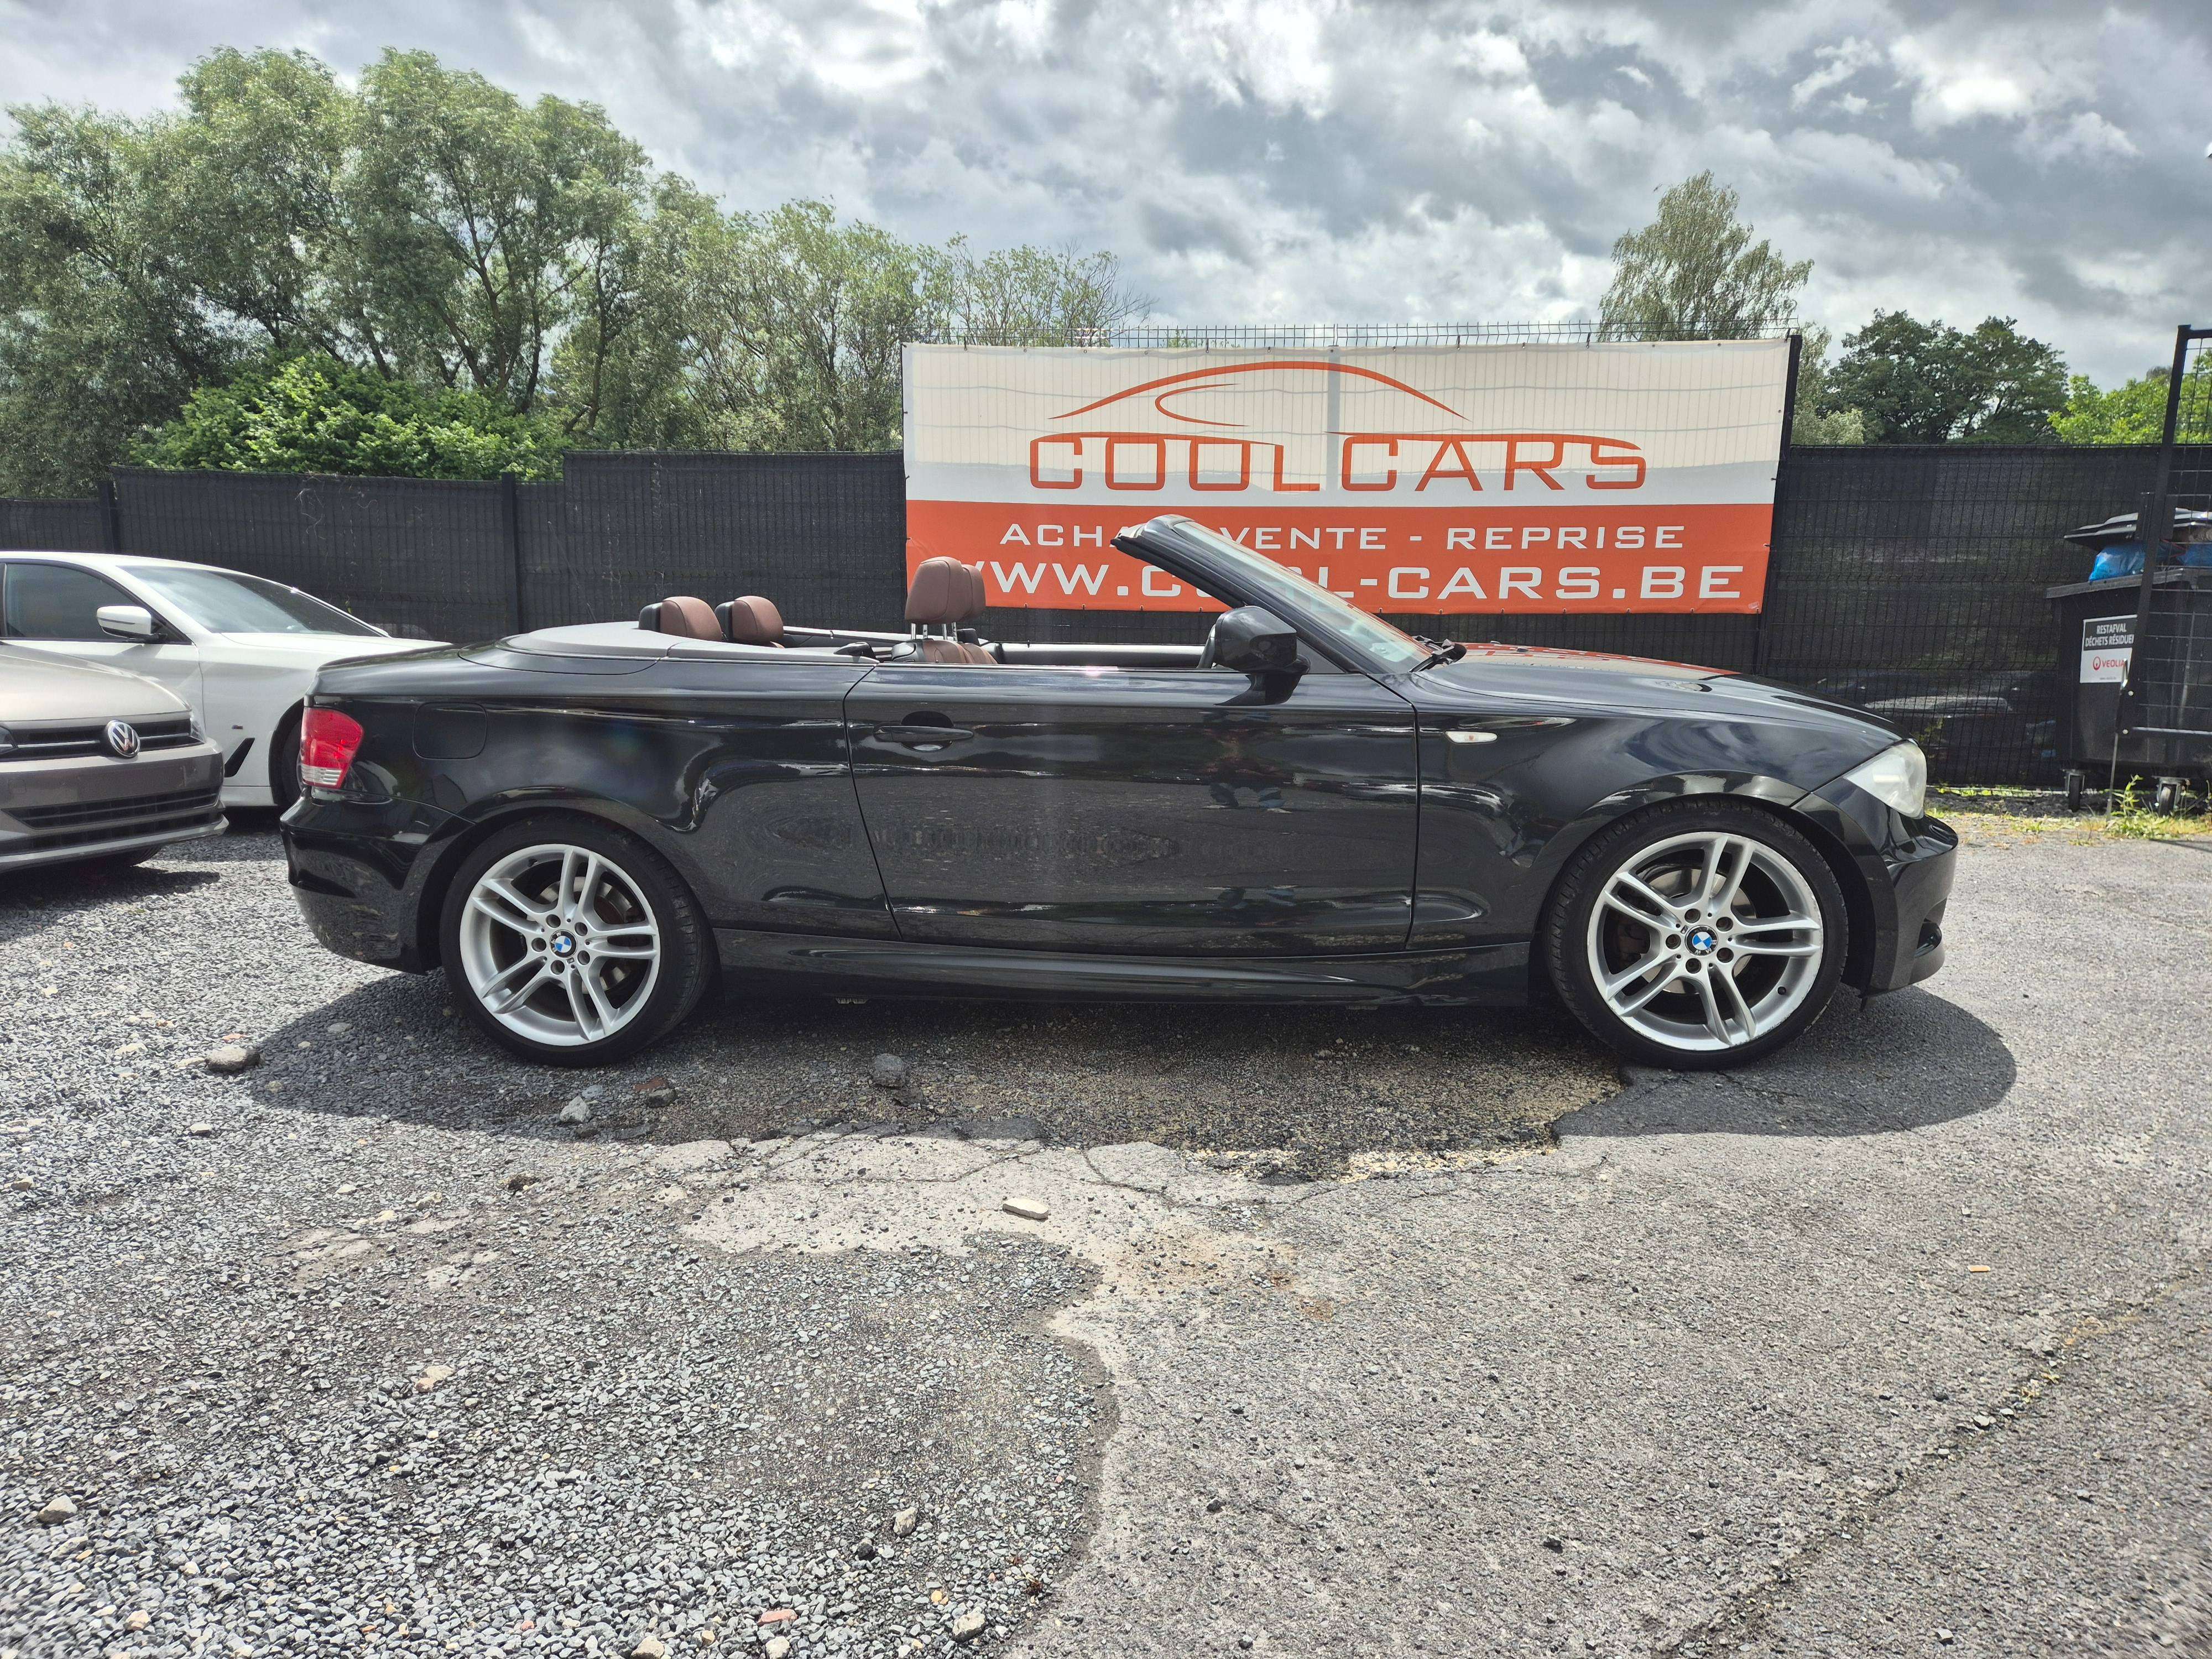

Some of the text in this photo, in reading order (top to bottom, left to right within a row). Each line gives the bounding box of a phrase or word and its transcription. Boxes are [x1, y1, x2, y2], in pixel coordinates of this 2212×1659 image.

[1030, 432, 1646, 492] COOL CARS
[1219, 527, 1386, 549] VENTE
[1447, 525, 1684, 549] REPRISE
[2096, 623, 2127, 634] RESTAFVAL
[2085, 635, 2108, 647] DÉCHETS
